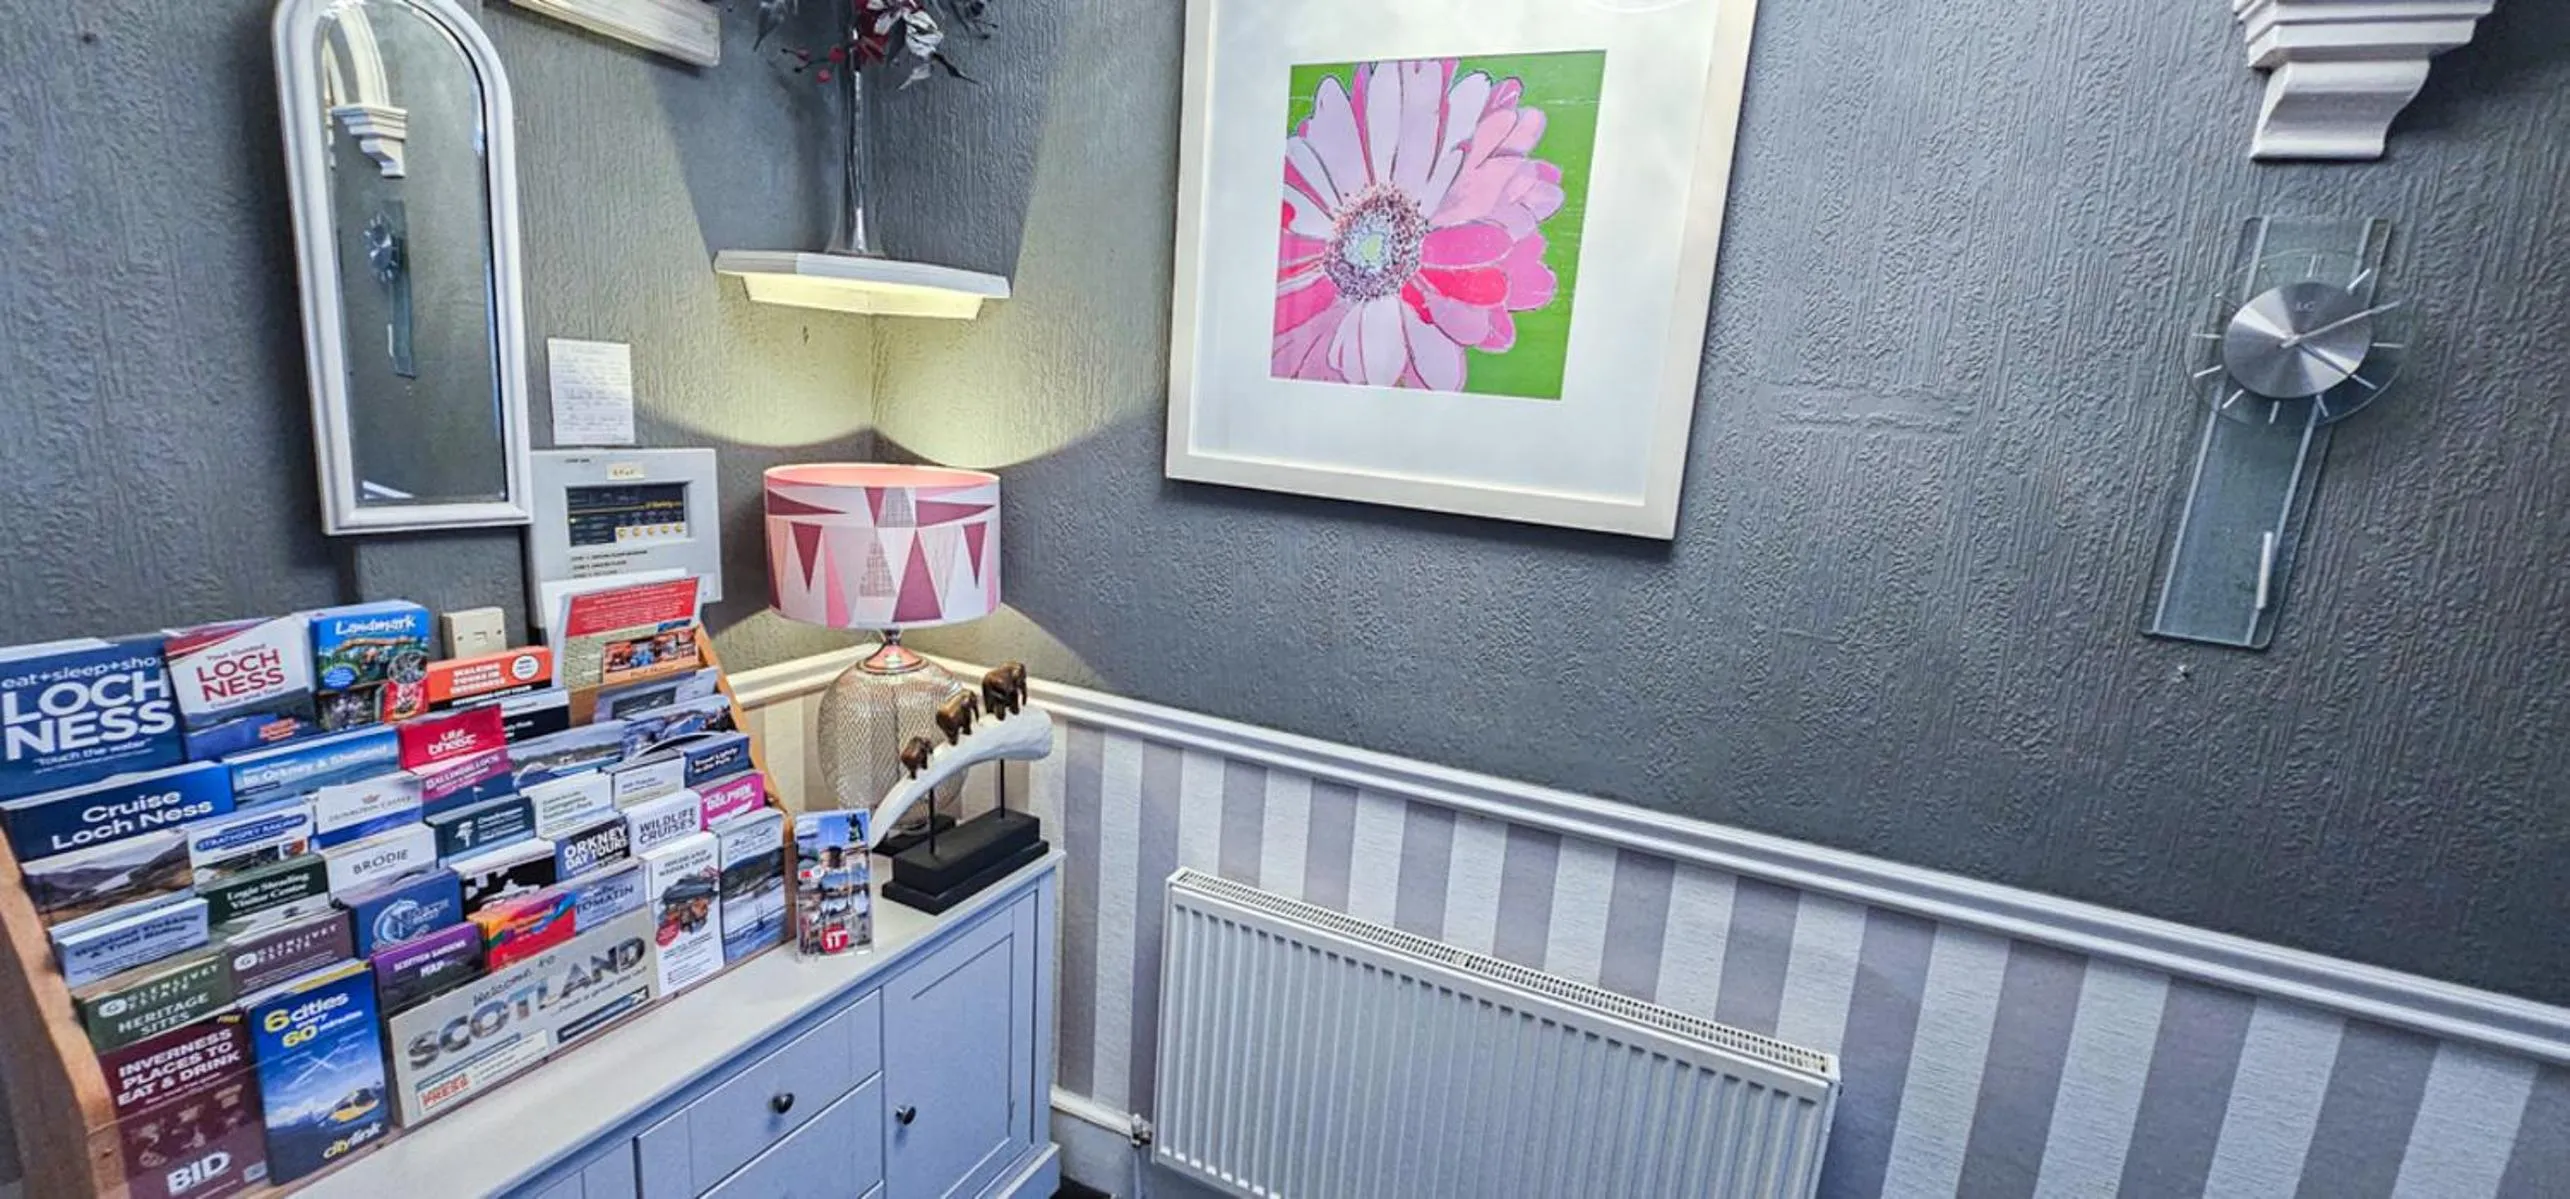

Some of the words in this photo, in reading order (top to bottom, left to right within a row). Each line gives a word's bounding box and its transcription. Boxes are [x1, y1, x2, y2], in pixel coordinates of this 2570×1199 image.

[335, 614, 417, 636] Landmark
[196, 648, 282, 683] LOCH
[2, 668, 172, 726] LOCH
[201, 667, 286, 703] NESS
[5, 699, 176, 761] NESS
[81, 788, 183, 824] Cruise
[639, 806, 696, 833] WILDLIFE
[51, 816, 135, 851] Loch
[139, 799, 214, 832] Ness
[564, 823, 628, 859] ORKNEY
[639, 817, 697, 845] CRUISES
[353, 848, 409, 876] BRODIE
[564, 850, 592, 872] DAY
[591, 836, 629, 864] TOURS
[576, 884, 634, 915] TOMATIN
[118, 992, 209, 1034] HERITAGE
[263, 1008, 291, 1034] 6
[290, 992, 350, 1023] cities
[407, 936, 647, 1072] SCOTLAND
[140, 1010, 191, 1036] SITES
[281, 1023, 318, 1049] 60
[117, 1028, 233, 1079] INVERNESS
[121, 1051, 203, 1091] PLACES
[208, 1040, 234, 1058] TO
[116, 1081, 158, 1107] EAT
[160, 1076, 176, 1091] &
[179, 1049, 241, 1084] DRINK
[322, 1121, 382, 1160] citylink
[165, 1150, 232, 1197] BID
